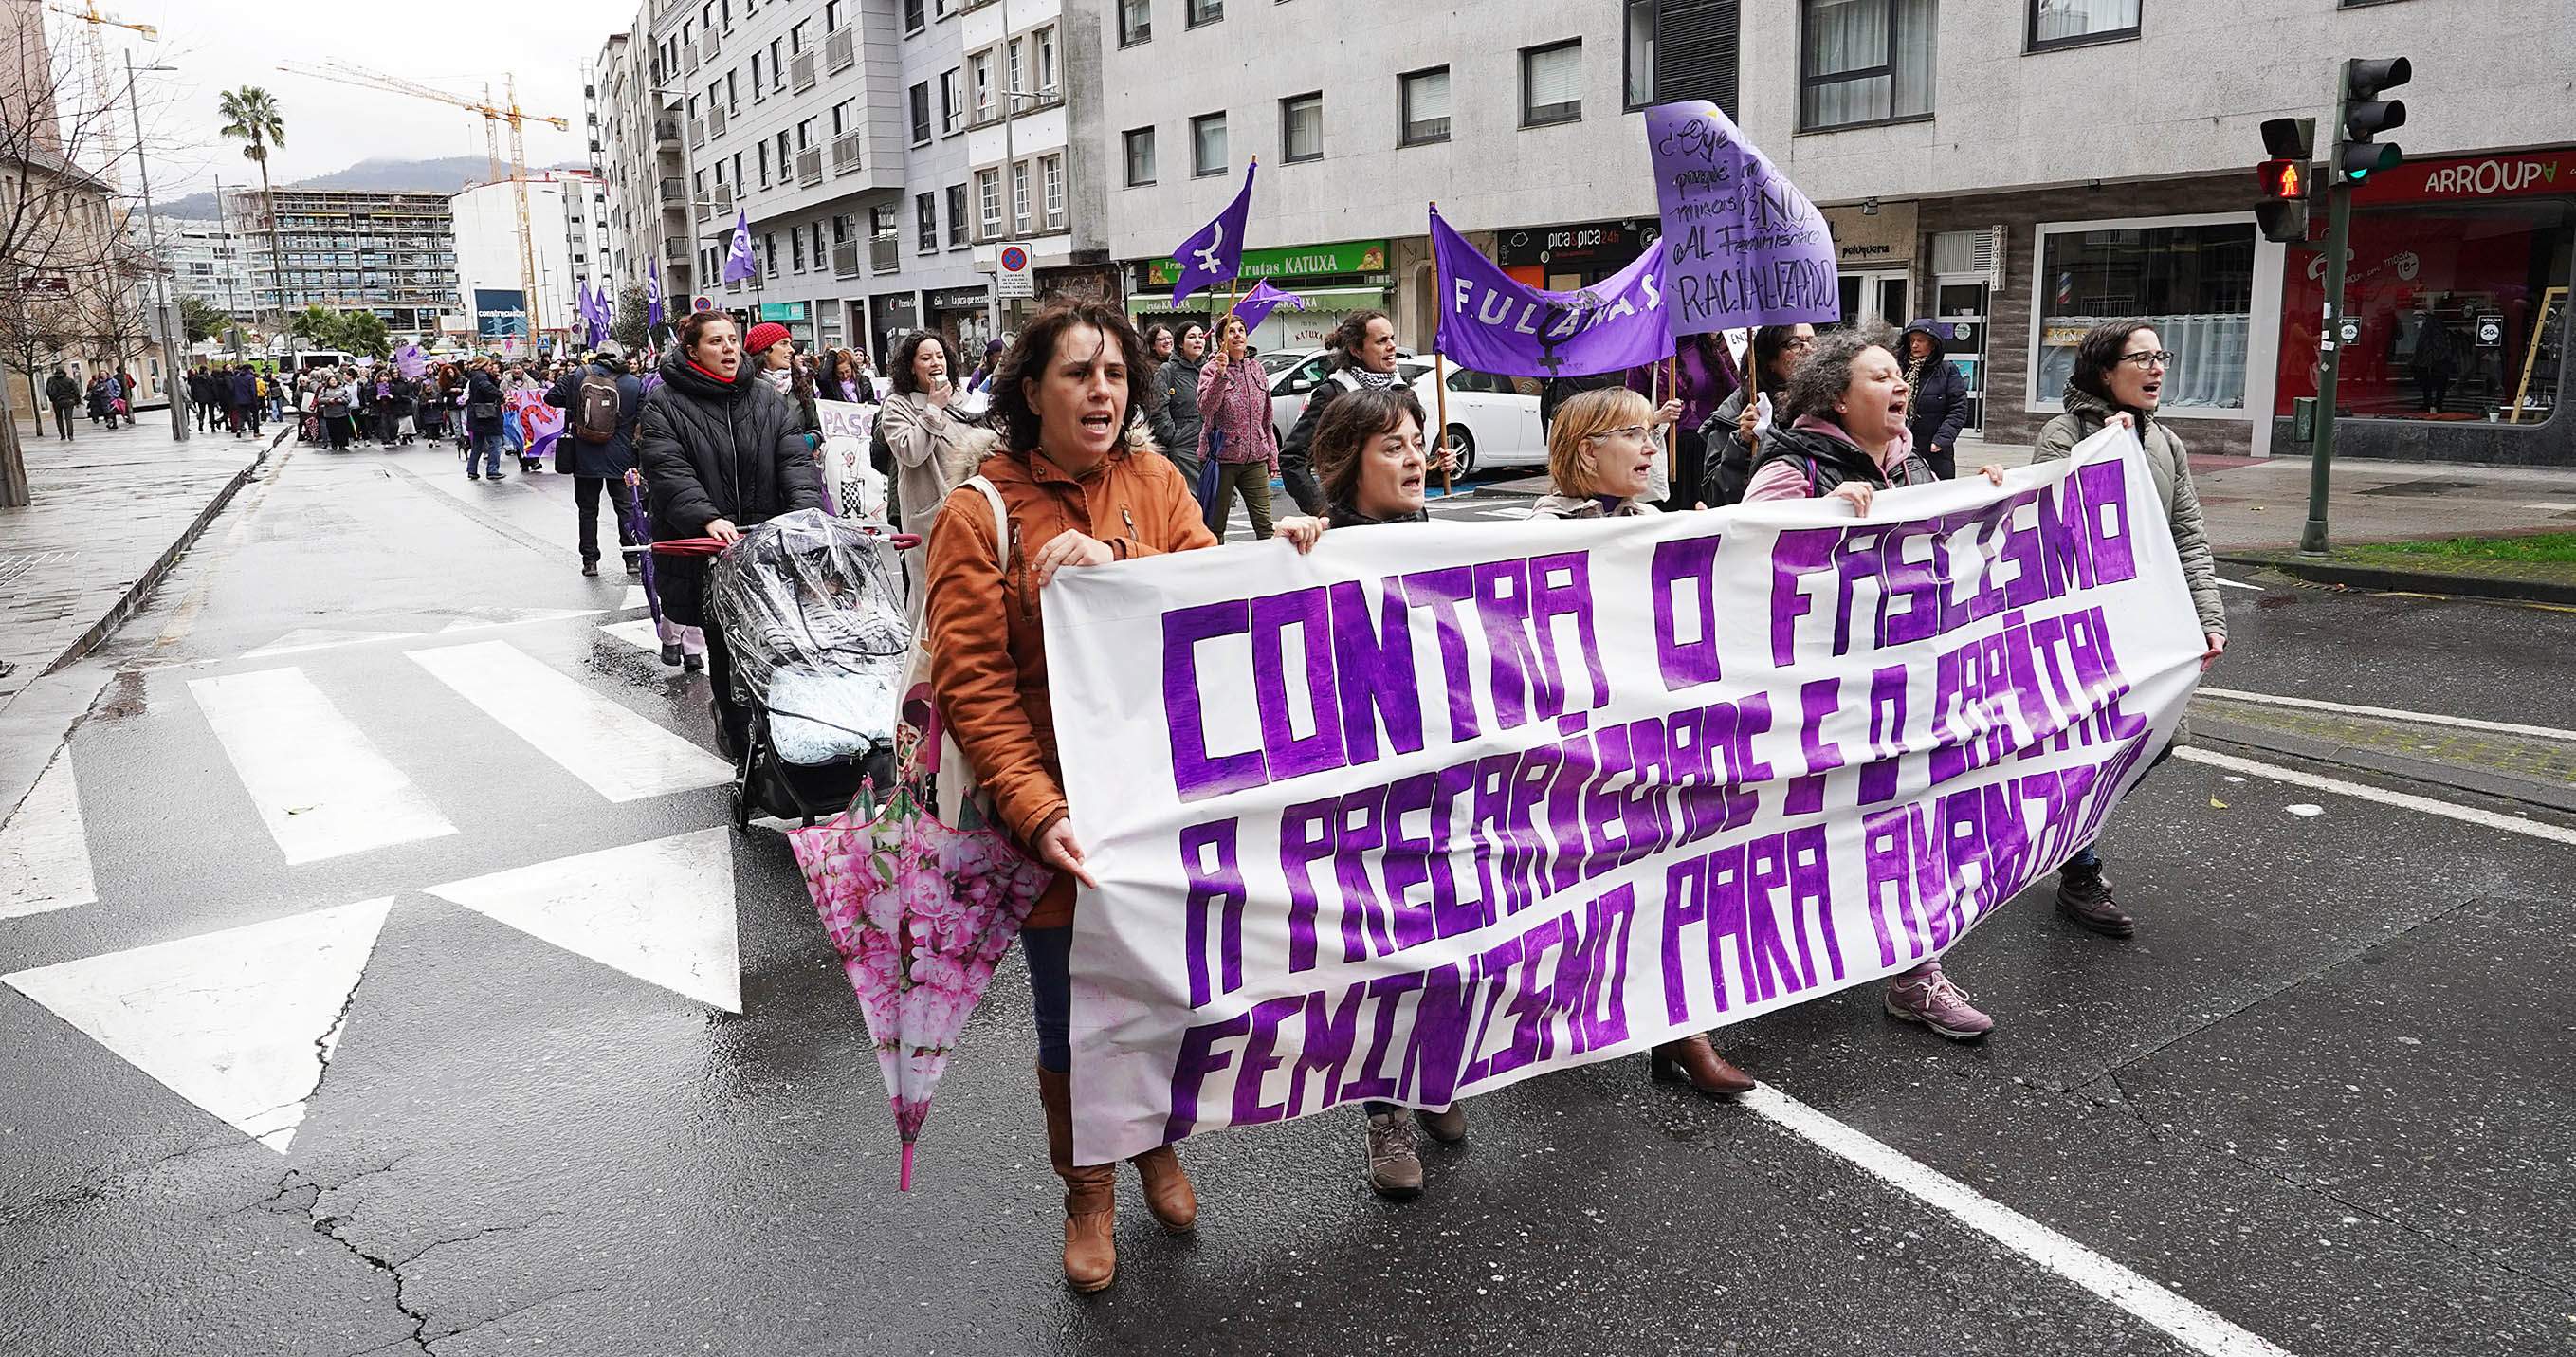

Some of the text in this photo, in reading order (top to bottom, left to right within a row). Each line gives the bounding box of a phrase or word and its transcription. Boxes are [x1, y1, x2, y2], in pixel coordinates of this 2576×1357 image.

[1285, 254, 1338, 274] KATUXA
[1679, 258, 1835, 323] RACIALIZADO
[1760, 183, 1806, 228] NO
[1161, 459, 2137, 803] CONTRA O FASCISMO
[1179, 817, 1246, 1009] A
[1783, 677, 1845, 816] E
[1857, 664, 1909, 805] O
[1929, 605, 2147, 786] CAPITAL
[1164, 882, 1630, 1146] FEMINISMO
[1661, 824, 1845, 1027] PARA
